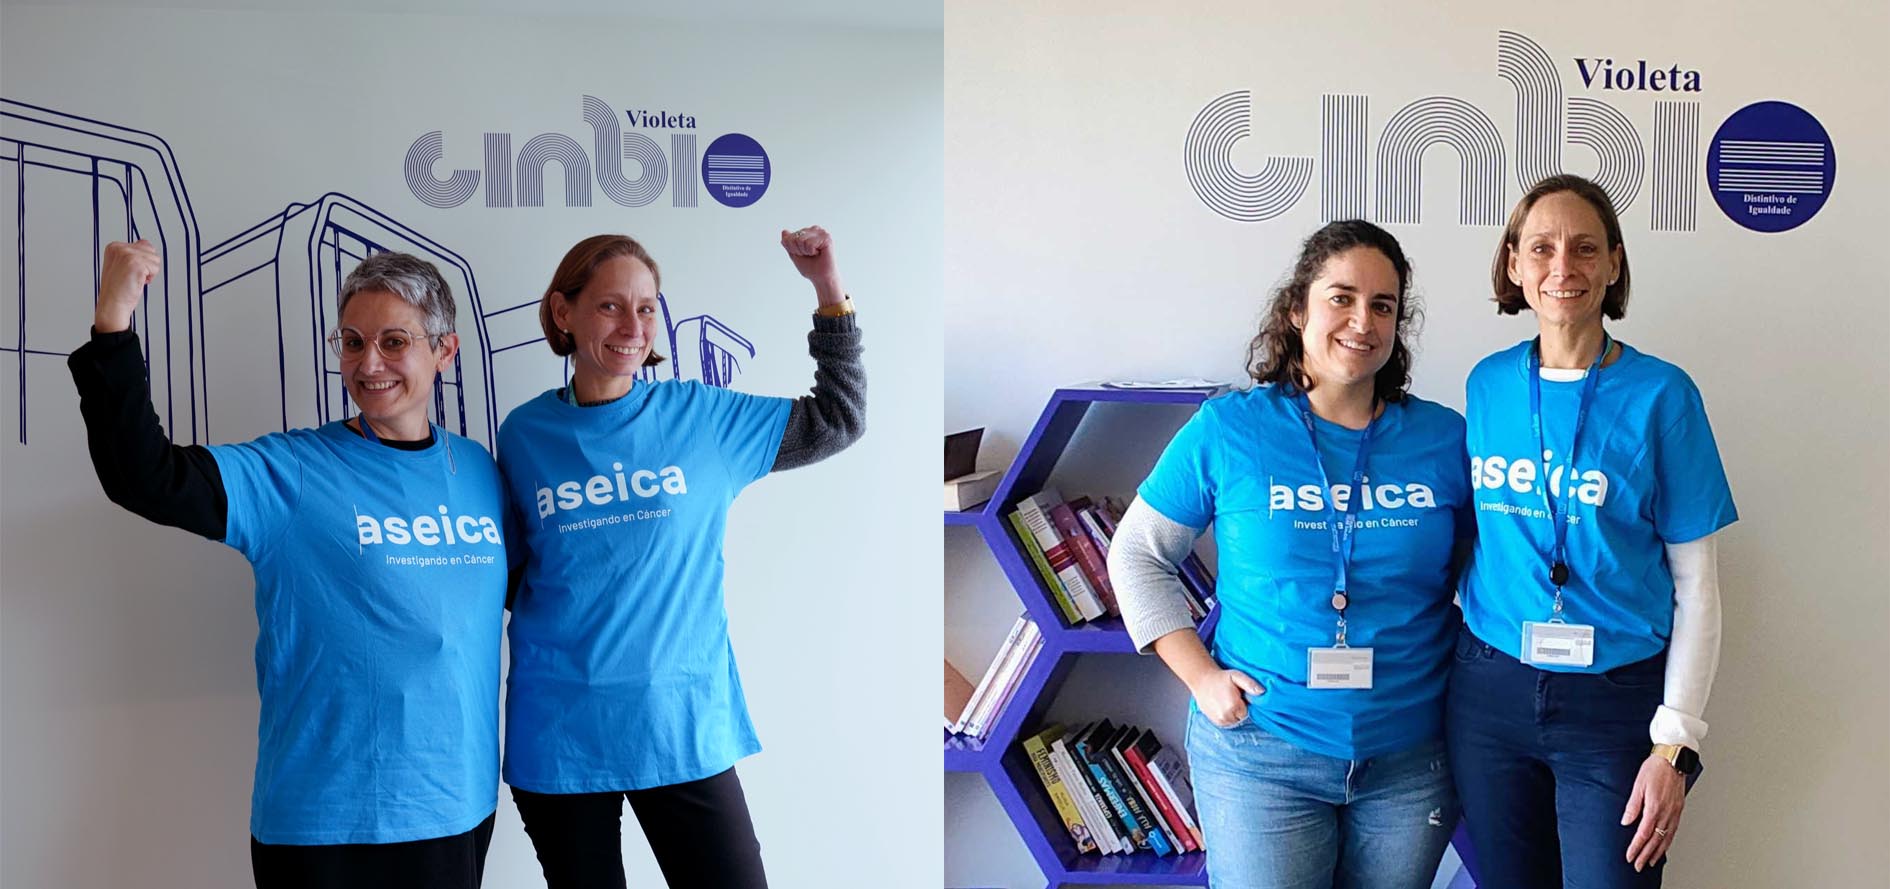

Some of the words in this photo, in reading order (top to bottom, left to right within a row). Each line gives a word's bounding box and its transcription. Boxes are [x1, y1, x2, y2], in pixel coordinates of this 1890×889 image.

[1574, 57, 1702, 93] Violeta
[626, 110, 697, 129] Violeta
[1744, 193, 1785, 204] Distintivo
[1786, 195, 1798, 204] de
[1748, 205, 1792, 216] Igualdade
[536, 462, 688, 520] aseica
[1270, 475, 1437, 512] aseica
[559, 514, 621, 534] Investigando
[623, 513, 635, 522] en
[637, 508, 672, 521] Cáncer
[1365, 520, 1379, 529] en
[1381, 517, 1419, 528] Cáncer
[1533, 508, 1546, 519] en
[357, 504, 502, 546] aseica
[386, 554, 449, 567] Investigando
[450, 557, 462, 565] en
[464, 554, 495, 565] Cáncer
[1099, 777, 1128, 818] ENFERMAS
